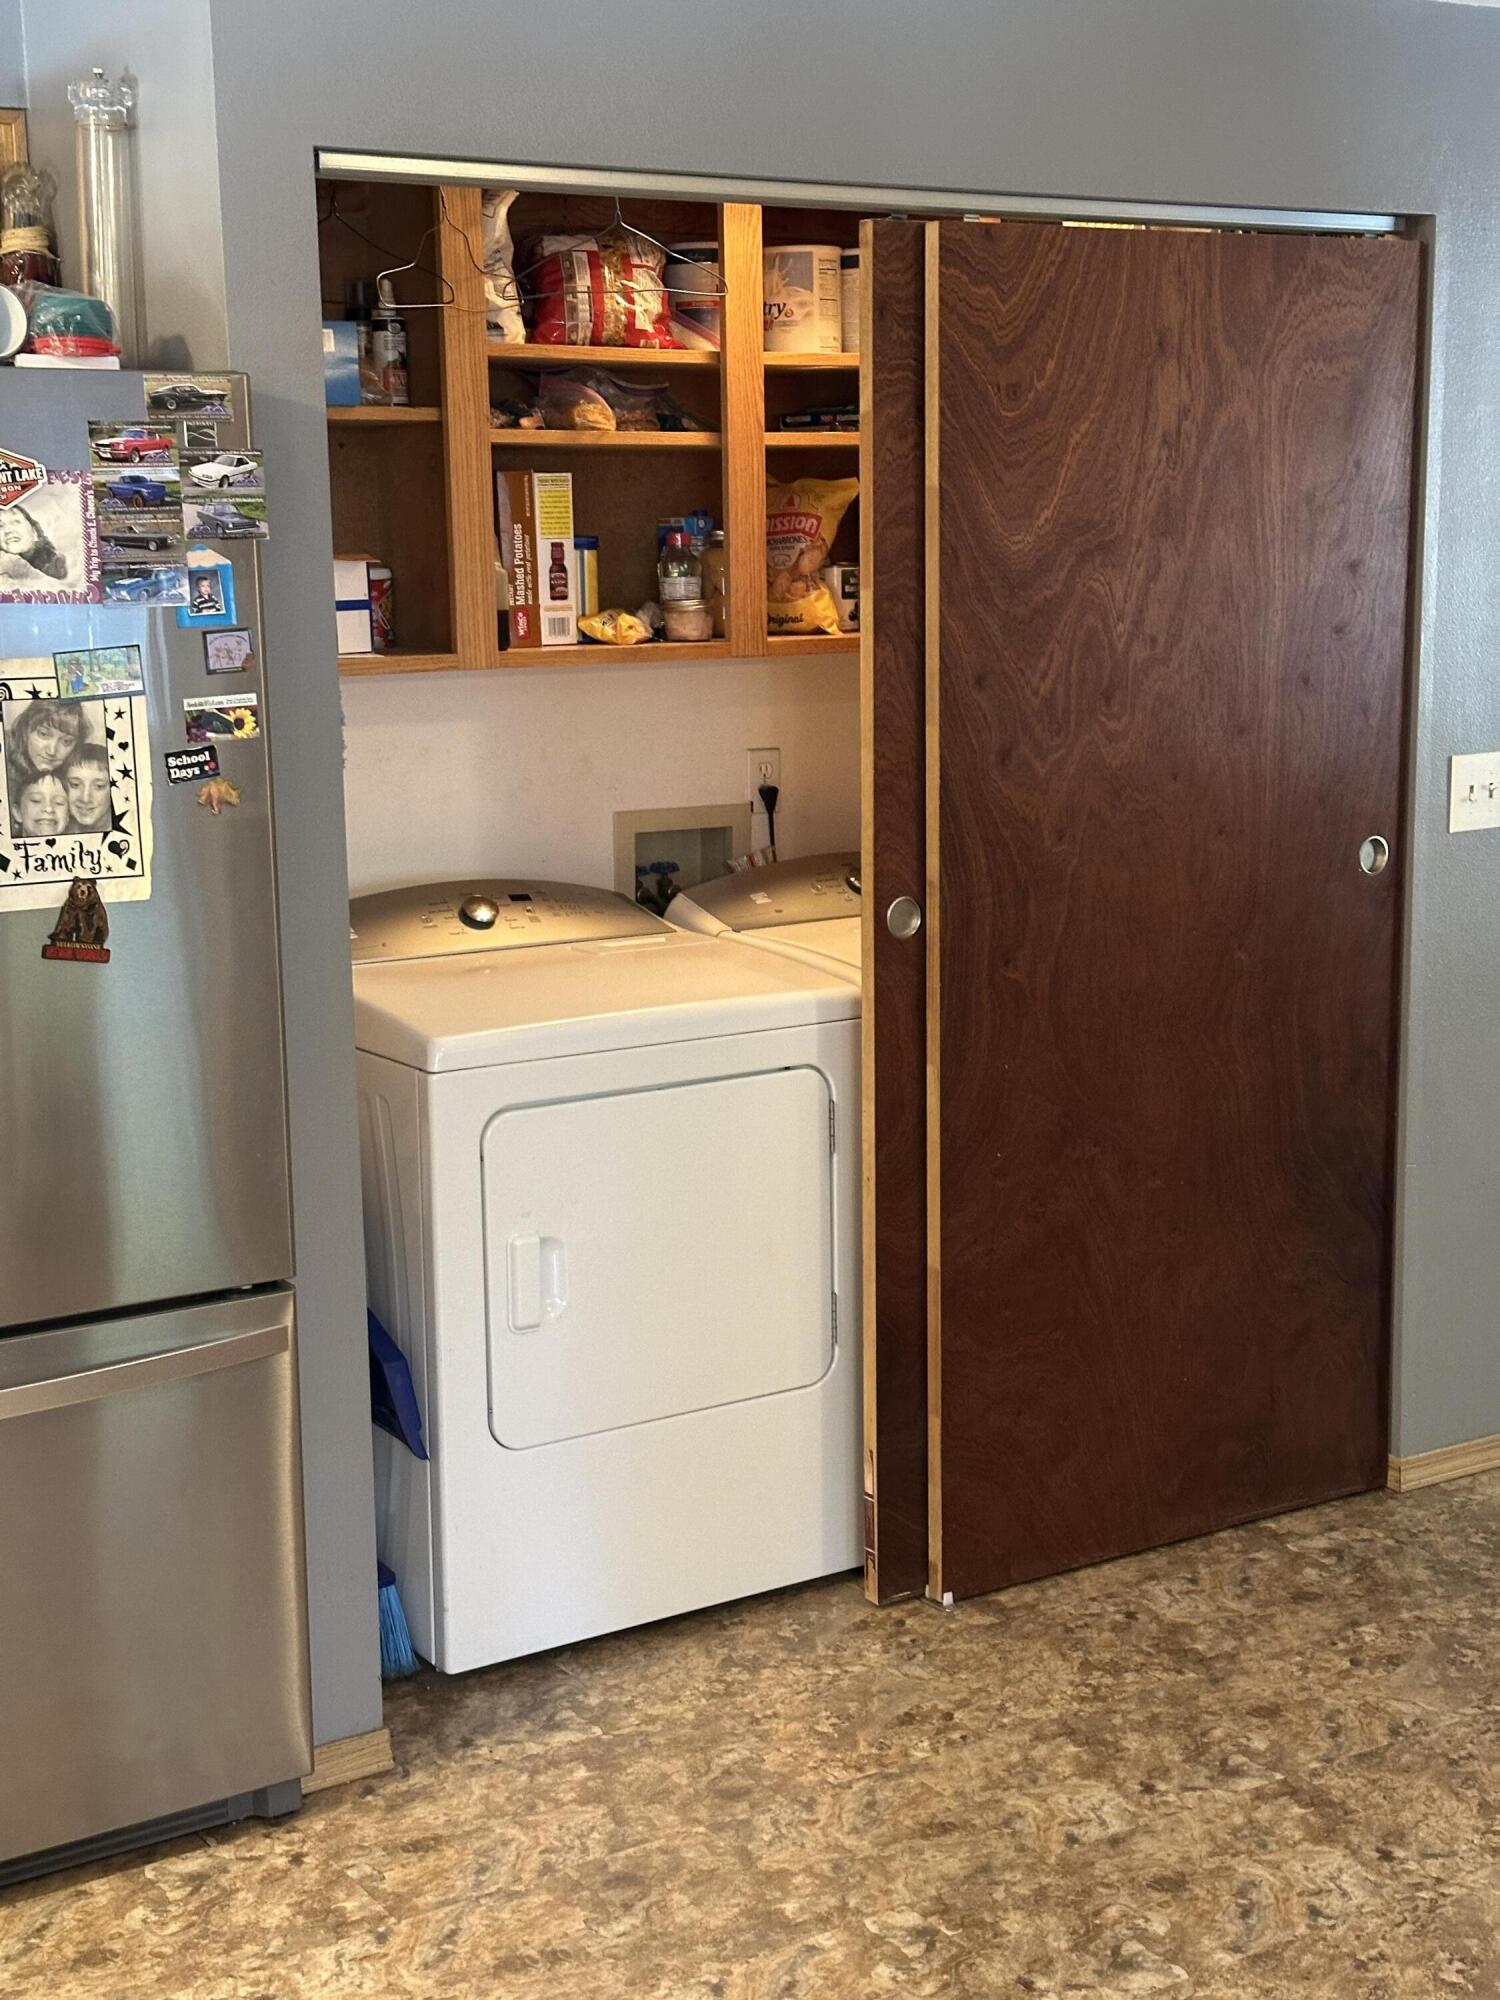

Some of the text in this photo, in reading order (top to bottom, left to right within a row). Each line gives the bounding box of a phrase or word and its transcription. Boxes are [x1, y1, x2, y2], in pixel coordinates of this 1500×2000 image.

[14, 468, 43, 482] LAKE
[89, 556, 101, 570] Trip
[513, 522, 526, 606] Mashed Potatoes
[89, 570, 101, 582] My
[167, 751, 211, 767] School
[169, 766, 201, 779] Days
[12, 840, 102, 875] Family
